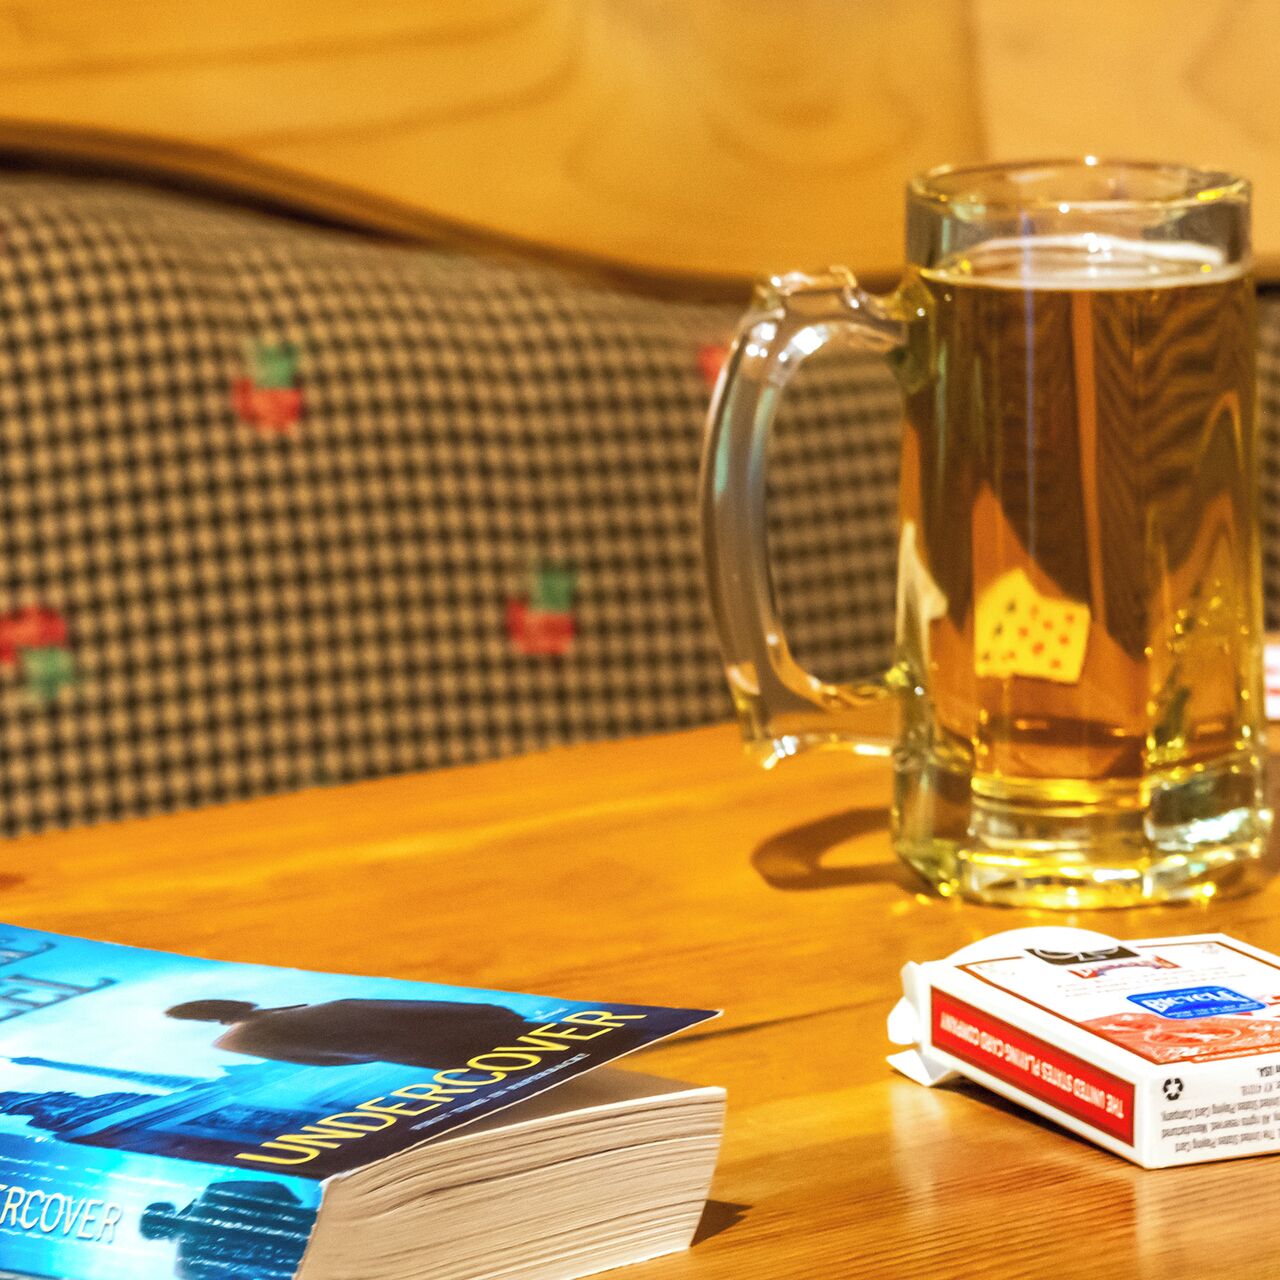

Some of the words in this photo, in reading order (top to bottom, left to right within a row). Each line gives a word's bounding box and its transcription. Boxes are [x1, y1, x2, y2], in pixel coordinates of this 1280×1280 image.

[235, 1010, 647, 1165] UNDERCOVER
[1041, 1061, 1073, 1093] STATES
[1105, 1093, 1124, 1119] THE
[0, 1184, 124, 1245] RCOVER
